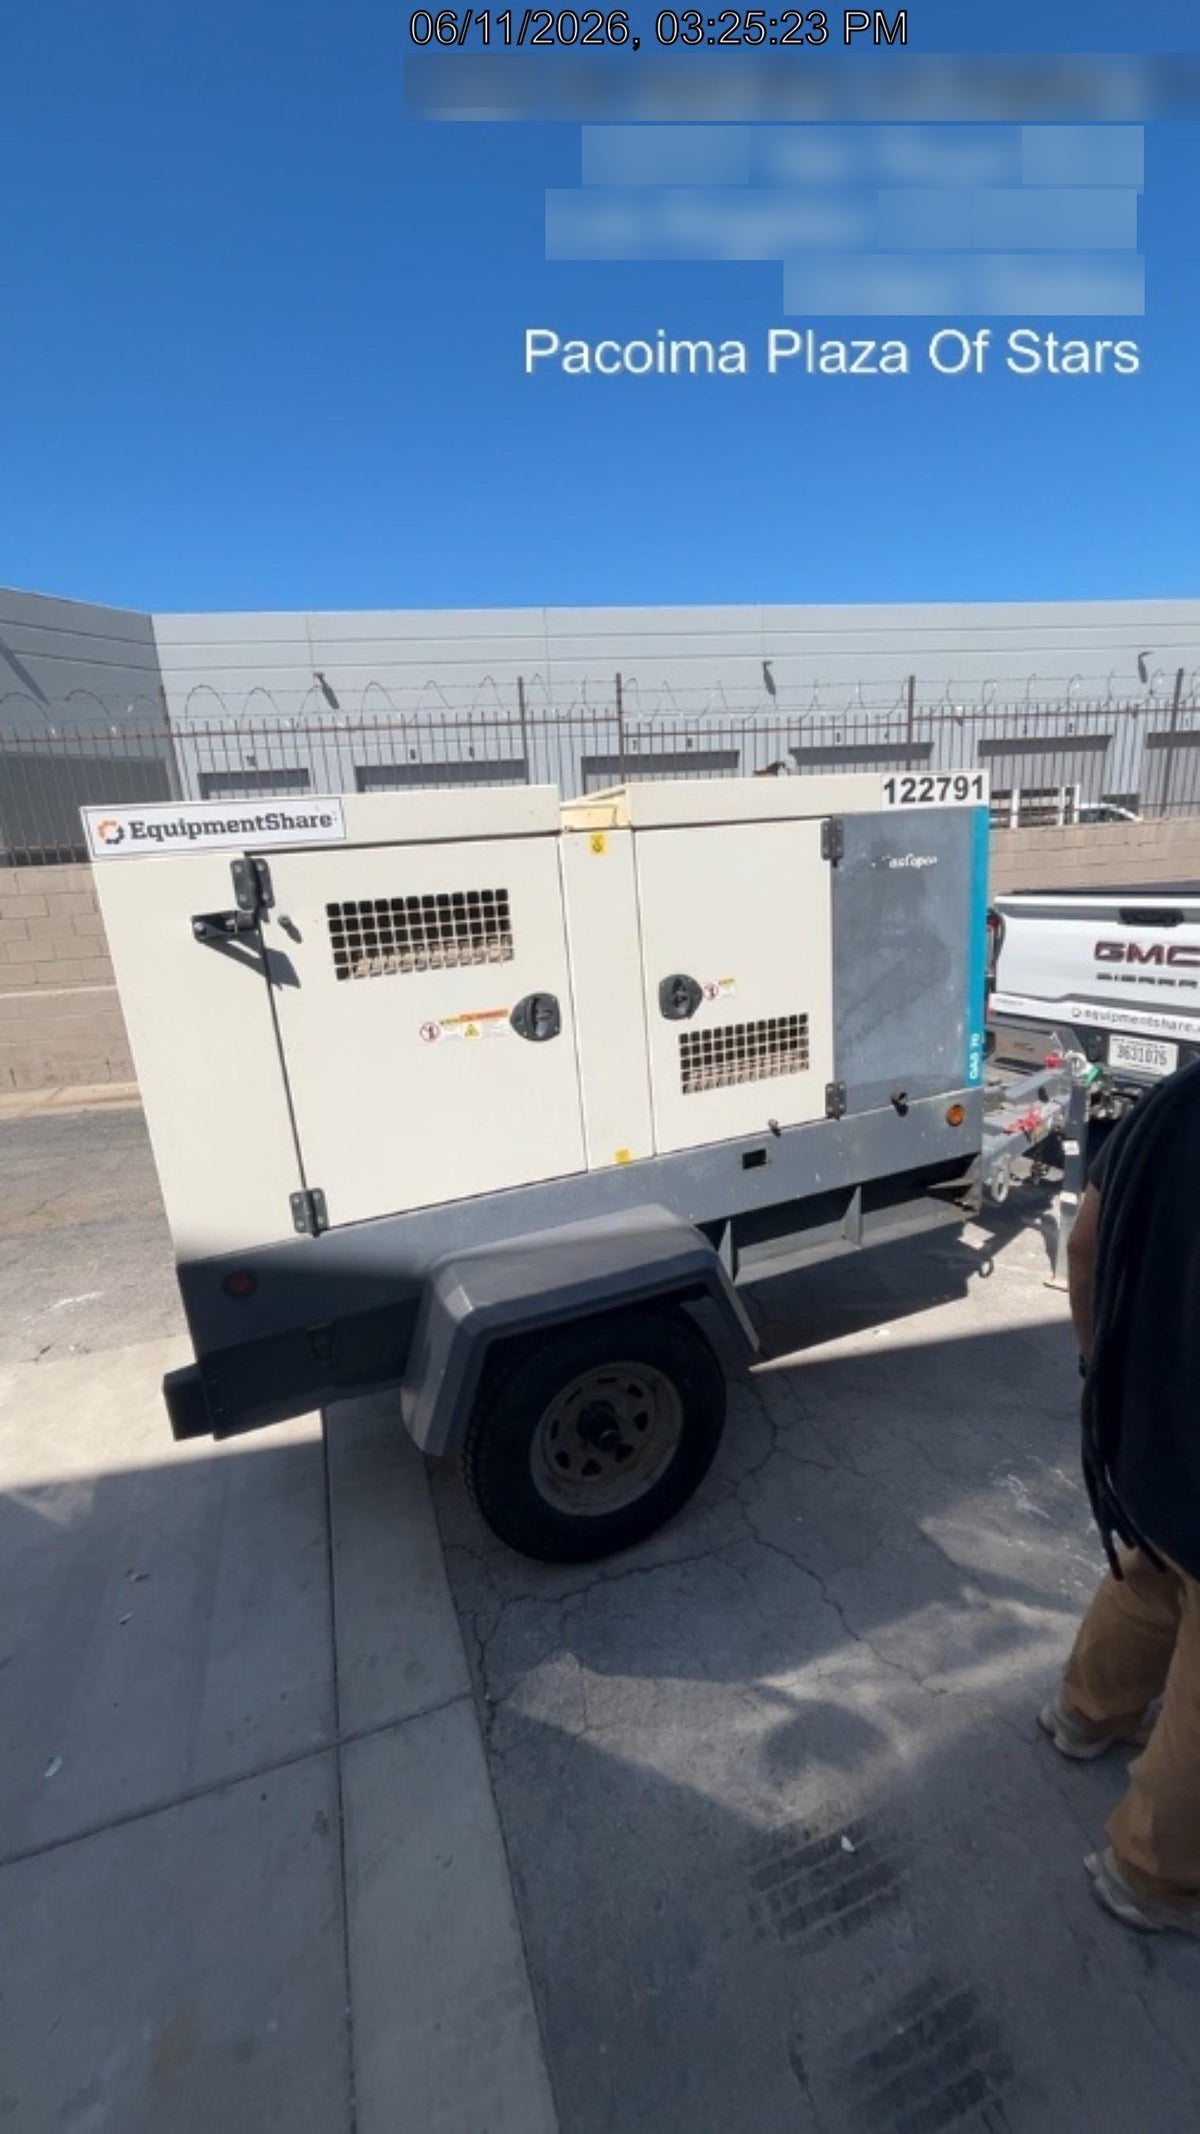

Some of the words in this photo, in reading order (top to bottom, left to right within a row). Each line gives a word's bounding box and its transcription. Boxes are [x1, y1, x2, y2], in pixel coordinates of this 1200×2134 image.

[883, 775, 984, 805] 122791
[128, 812, 334, 842] EquipmentShare
[1095, 941, 1200, 967] GMC
[1085, 1008, 1200, 1033] equipmentshare.
